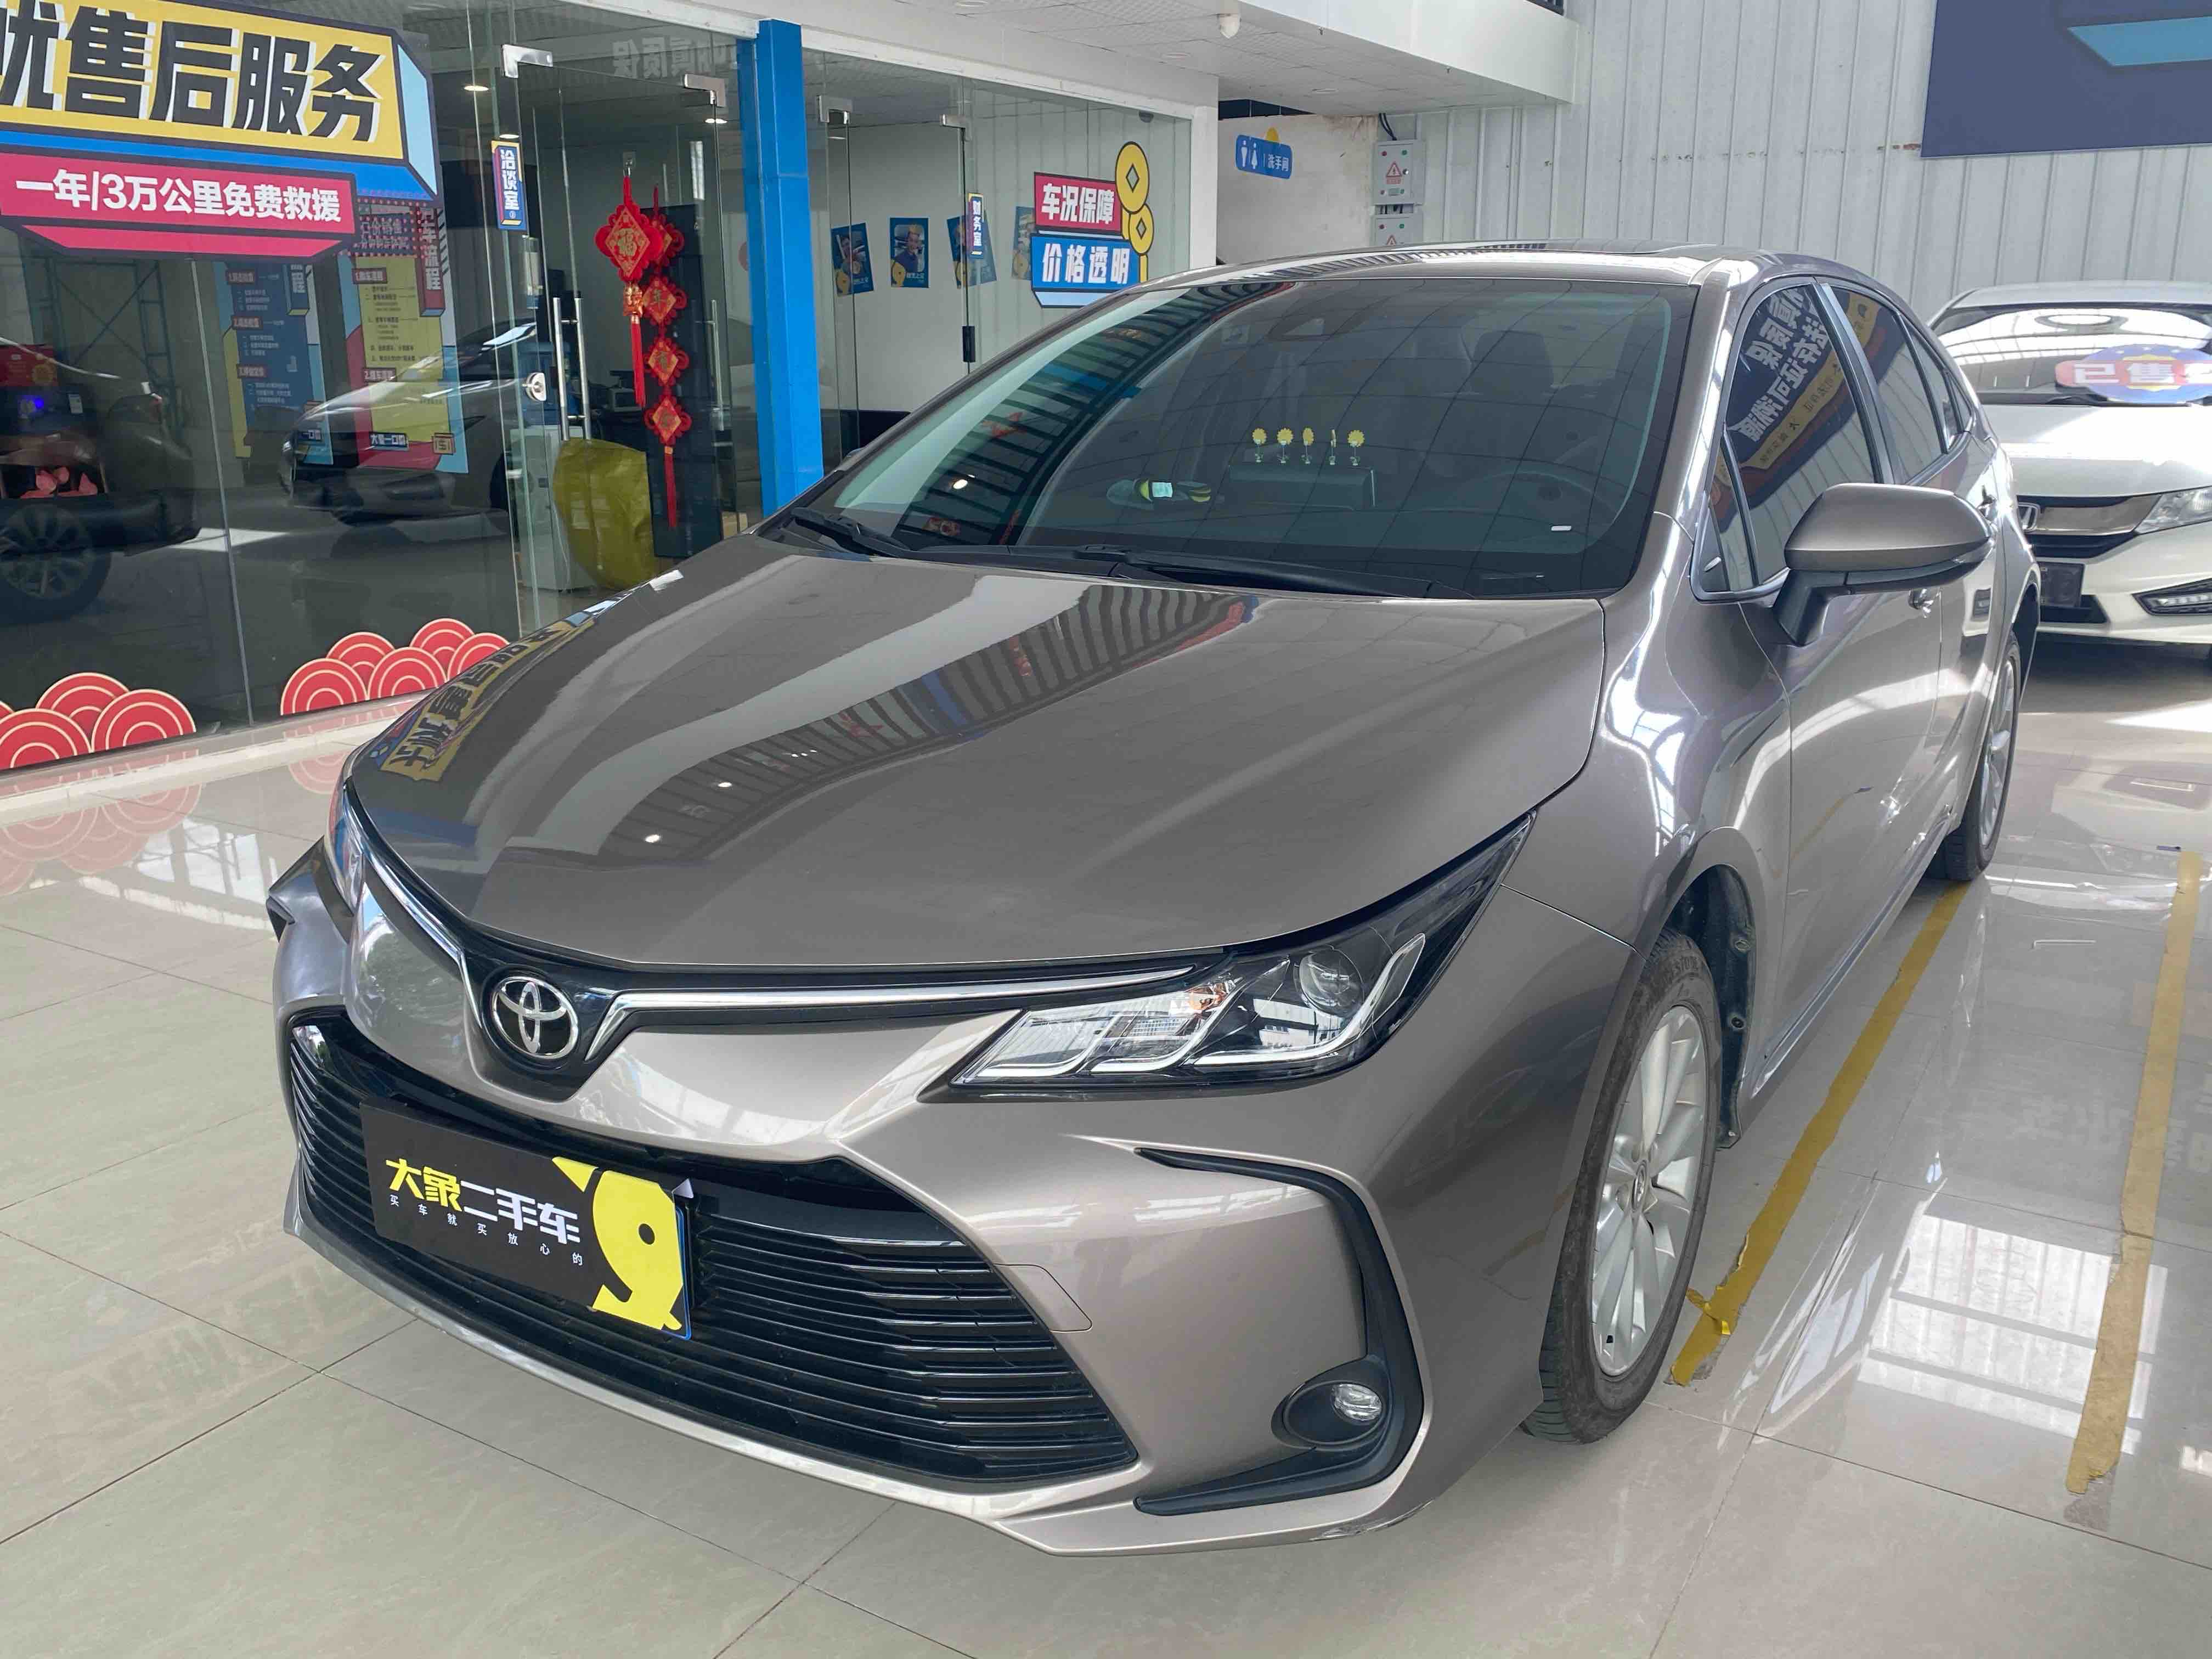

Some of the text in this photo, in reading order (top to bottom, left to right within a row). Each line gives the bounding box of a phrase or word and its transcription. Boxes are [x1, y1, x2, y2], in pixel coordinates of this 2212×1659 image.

[500, 149, 520, 211] 洽谈室
[1041, 183, 1115, 224] 车况保障
[1042, 242, 1131, 285] 价格透明
[386, 1158, 581, 1244] 大象二手车
[390, 1194, 583, 1266] 买车就买放心的
